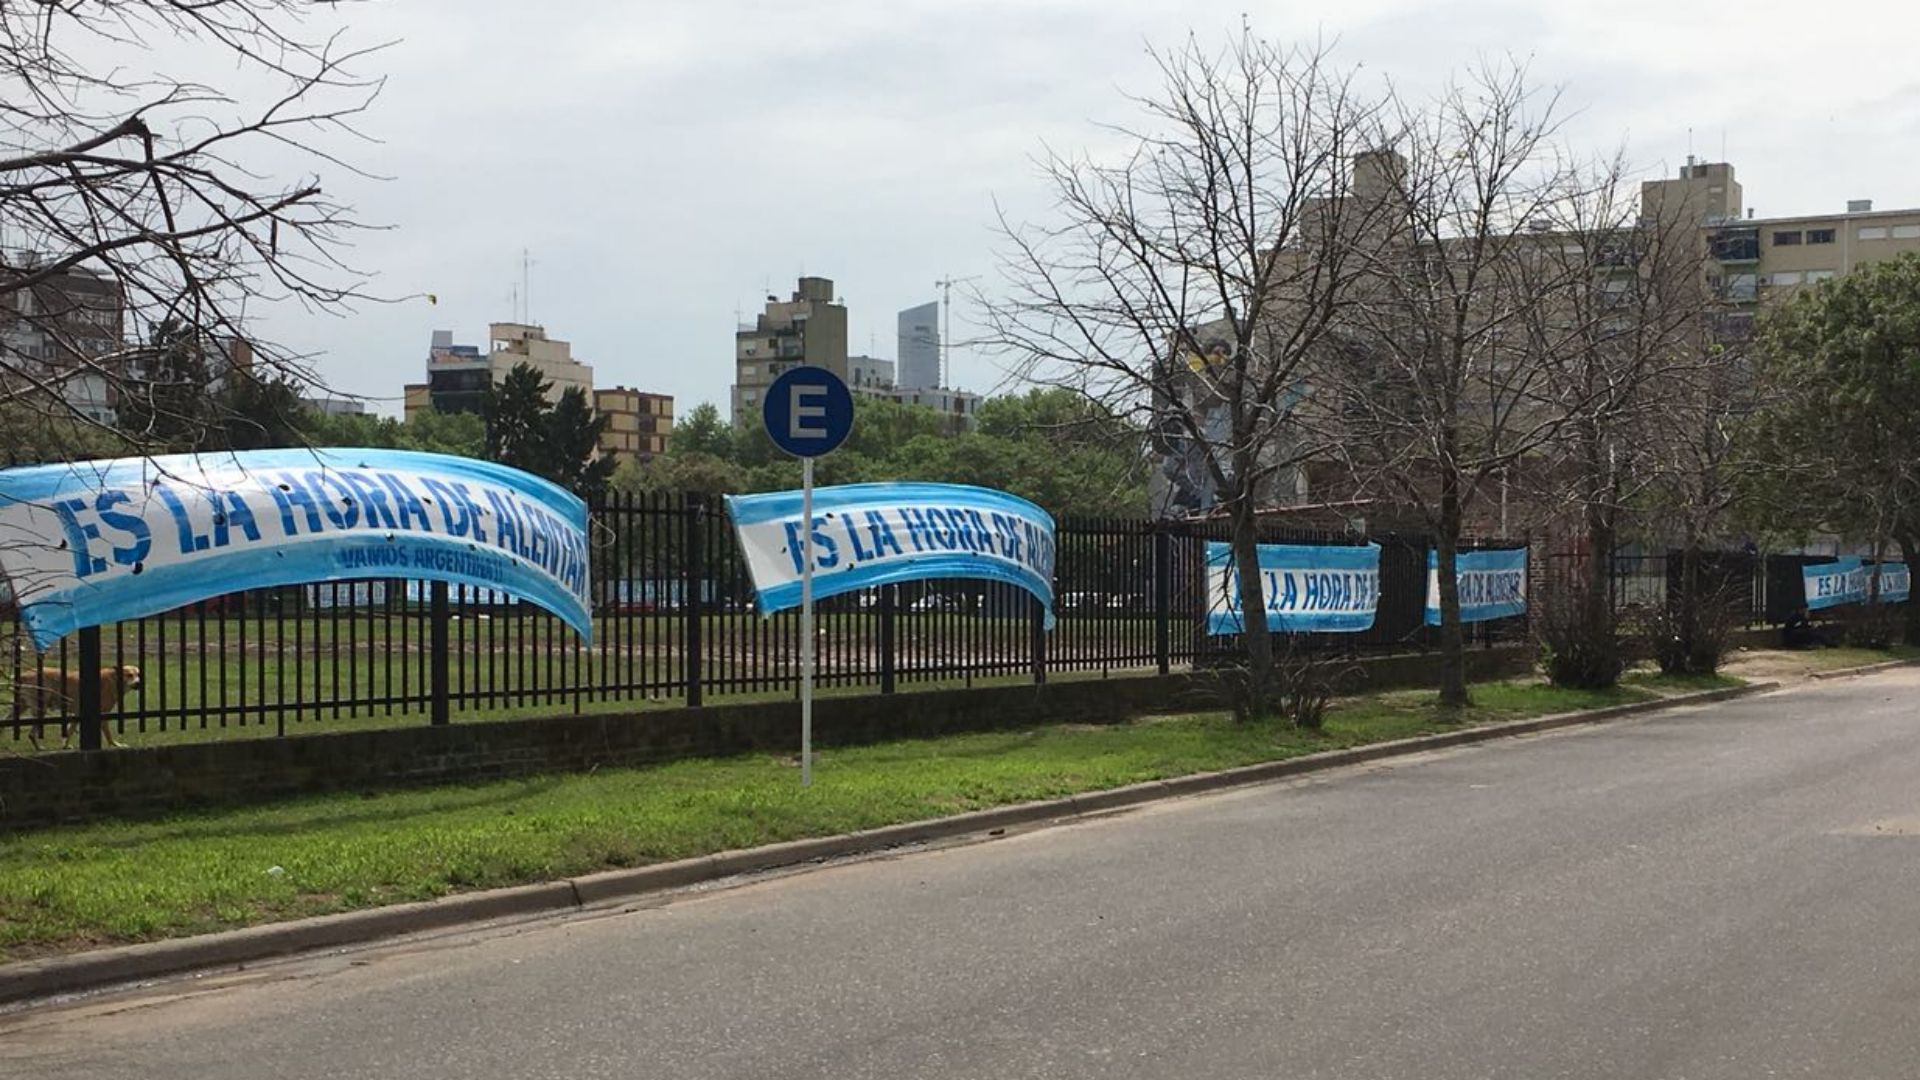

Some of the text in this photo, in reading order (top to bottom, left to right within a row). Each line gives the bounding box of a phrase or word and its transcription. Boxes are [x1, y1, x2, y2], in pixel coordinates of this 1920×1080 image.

[790, 385, 828, 438] E
[53, 490, 151, 577] ES
[155, 484, 261, 554] LA
[258, 471, 433, 536] HORA
[419, 477, 487, 543] DE
[783, 520, 839, 575] ES
[841, 511, 901, 562] LA
[898, 508, 996, 555] HORA
[991, 512, 1023, 562] DE
[338, 545, 408, 568] VAMOS
[1268, 572, 1297, 610] LA
[1302, 573, 1350, 610] HORA
[1352, 573, 1368, 609] DE
